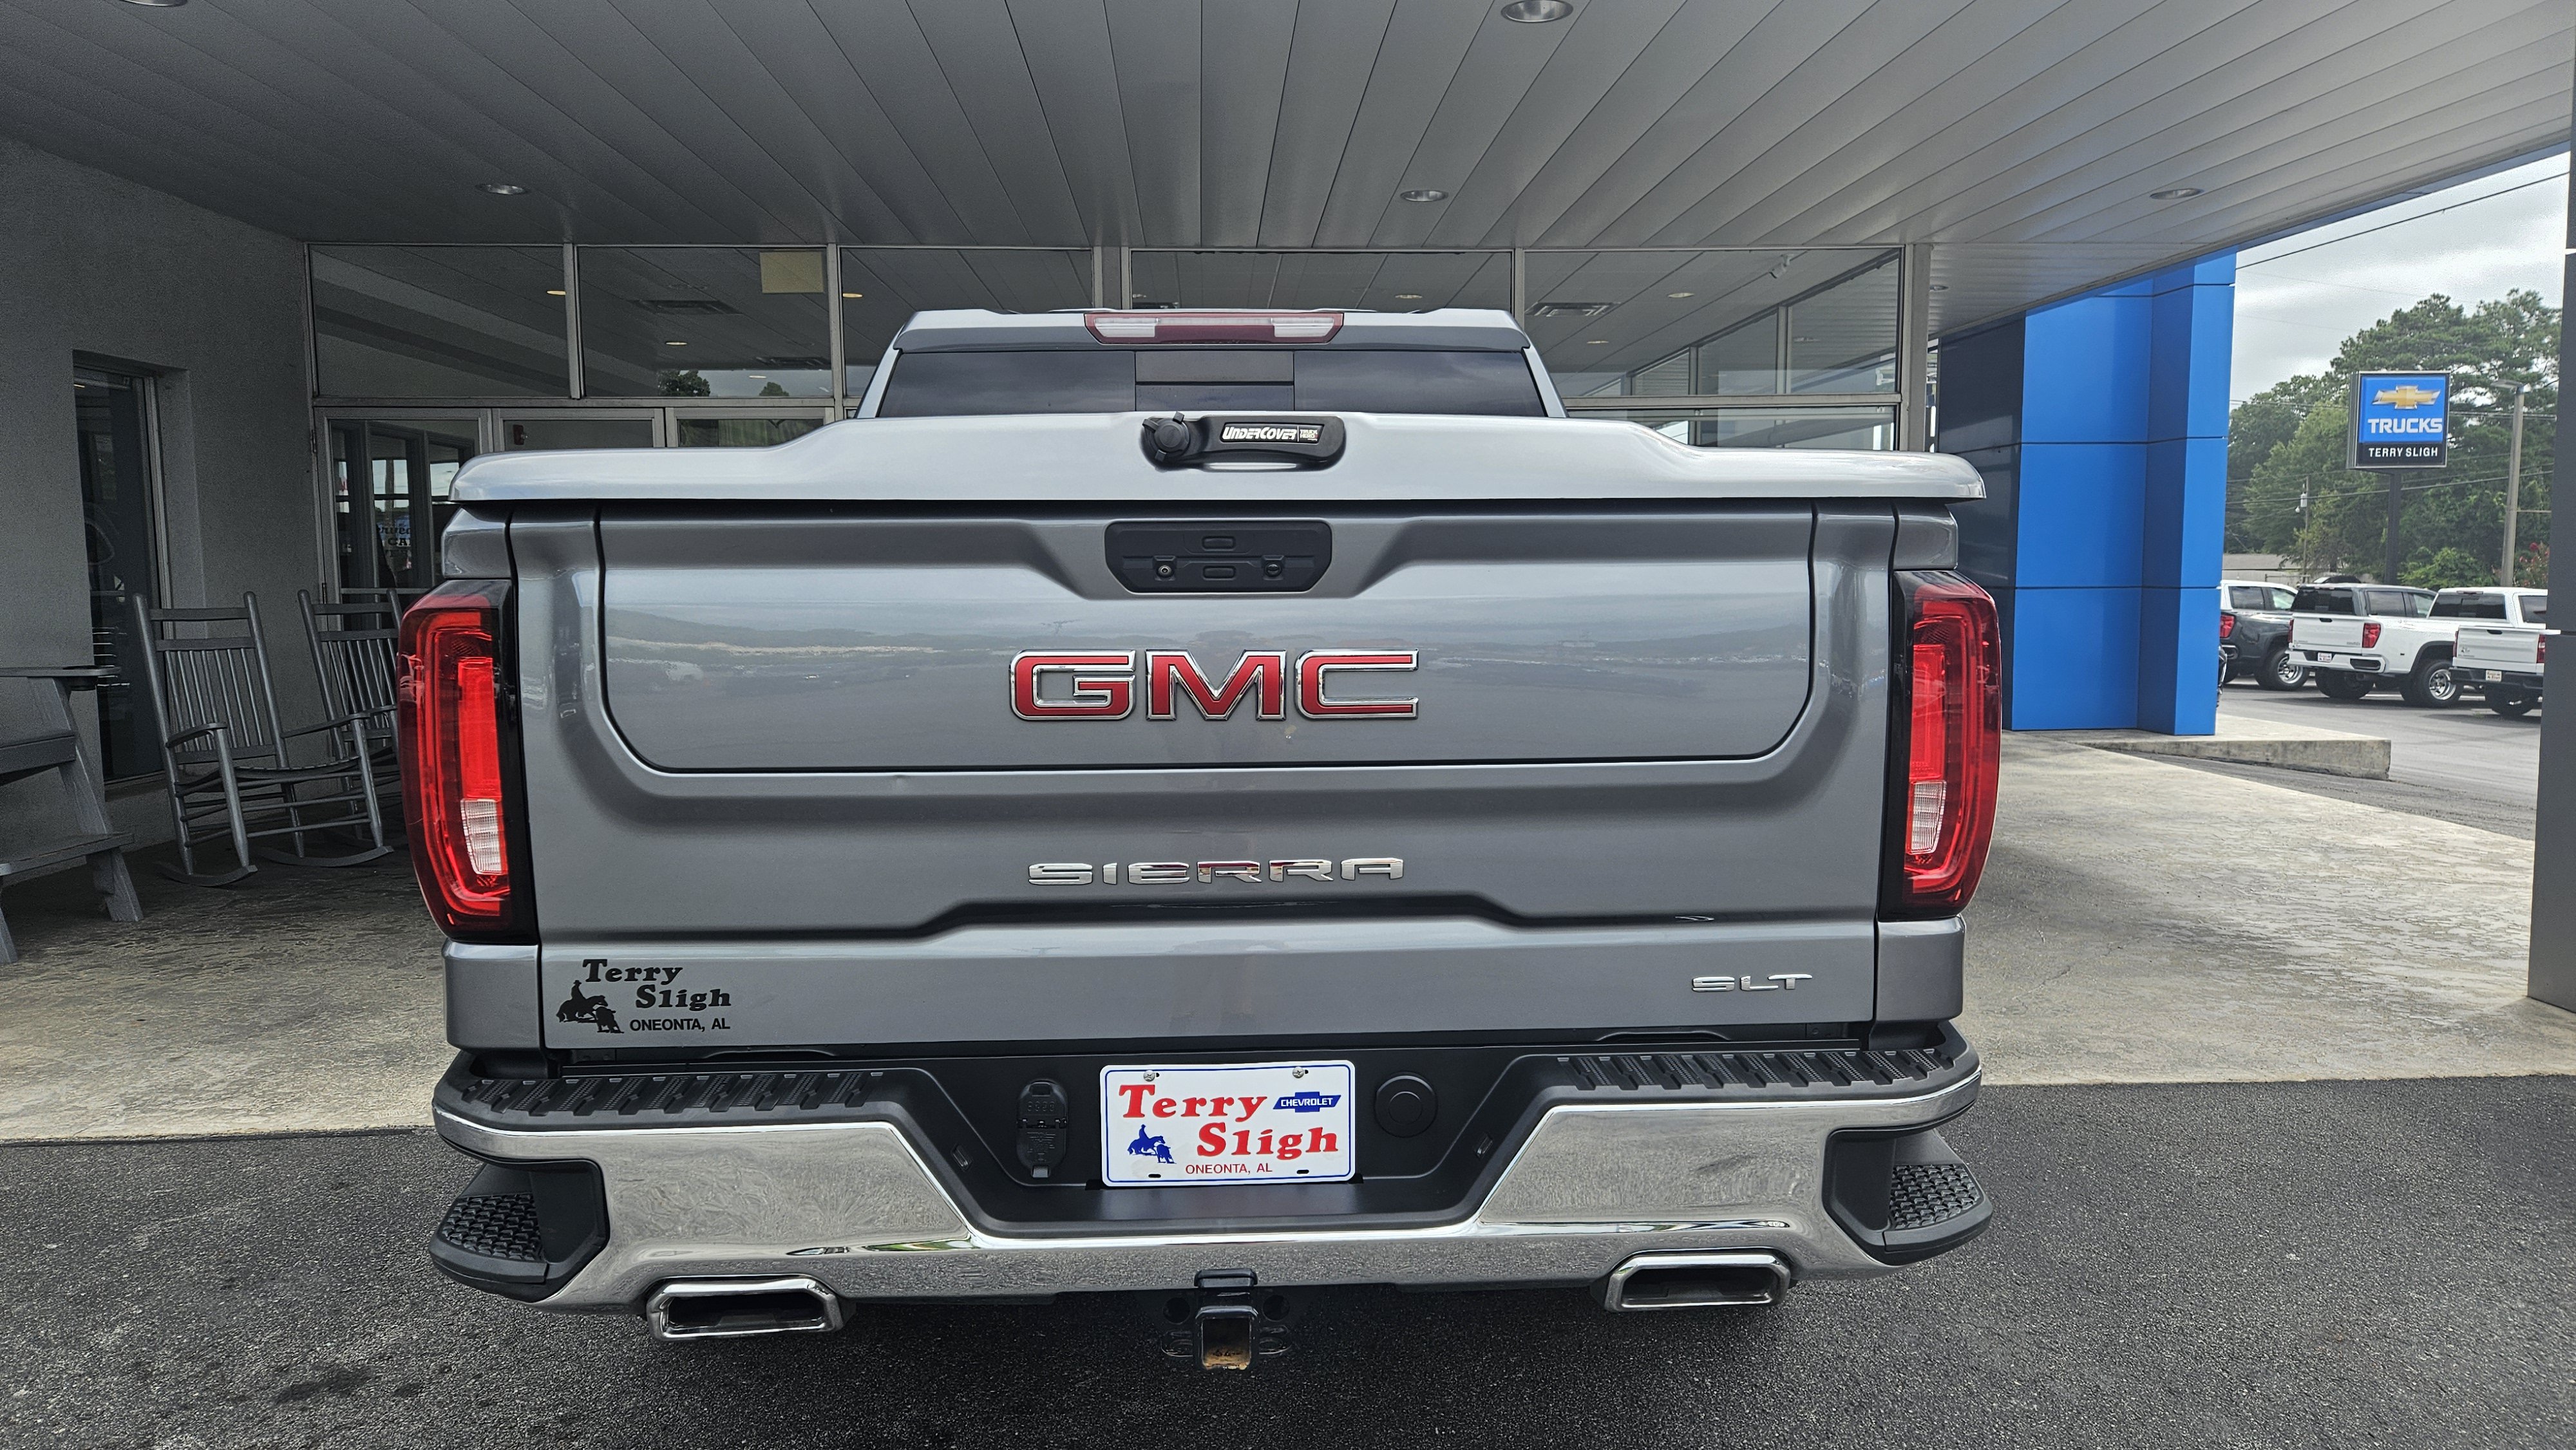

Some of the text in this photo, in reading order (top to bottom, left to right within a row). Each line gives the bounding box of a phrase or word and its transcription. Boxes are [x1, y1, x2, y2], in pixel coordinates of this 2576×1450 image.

[2367, 417, 2443, 433] TRUCKS
[2369, 447, 2438, 457] TERRY SLIGH
[1009, 648, 1419, 721] GMC
[1028, 858, 1404, 885] SIERRA
[582, 959, 683, 985] Terry
[1692, 974, 1813, 992] SLT
[635, 984, 732, 1011] Sligh
[629, 1018, 730, 1032] ONEONTA, AL
[1118, 1084, 1268, 1122] Terry
[1280, 1097, 1334, 1107] CHEVROLET
[1197, 1122, 1339, 1160] Sligh
[1185, 1162, 1273, 1175] ONEONTA, AL
